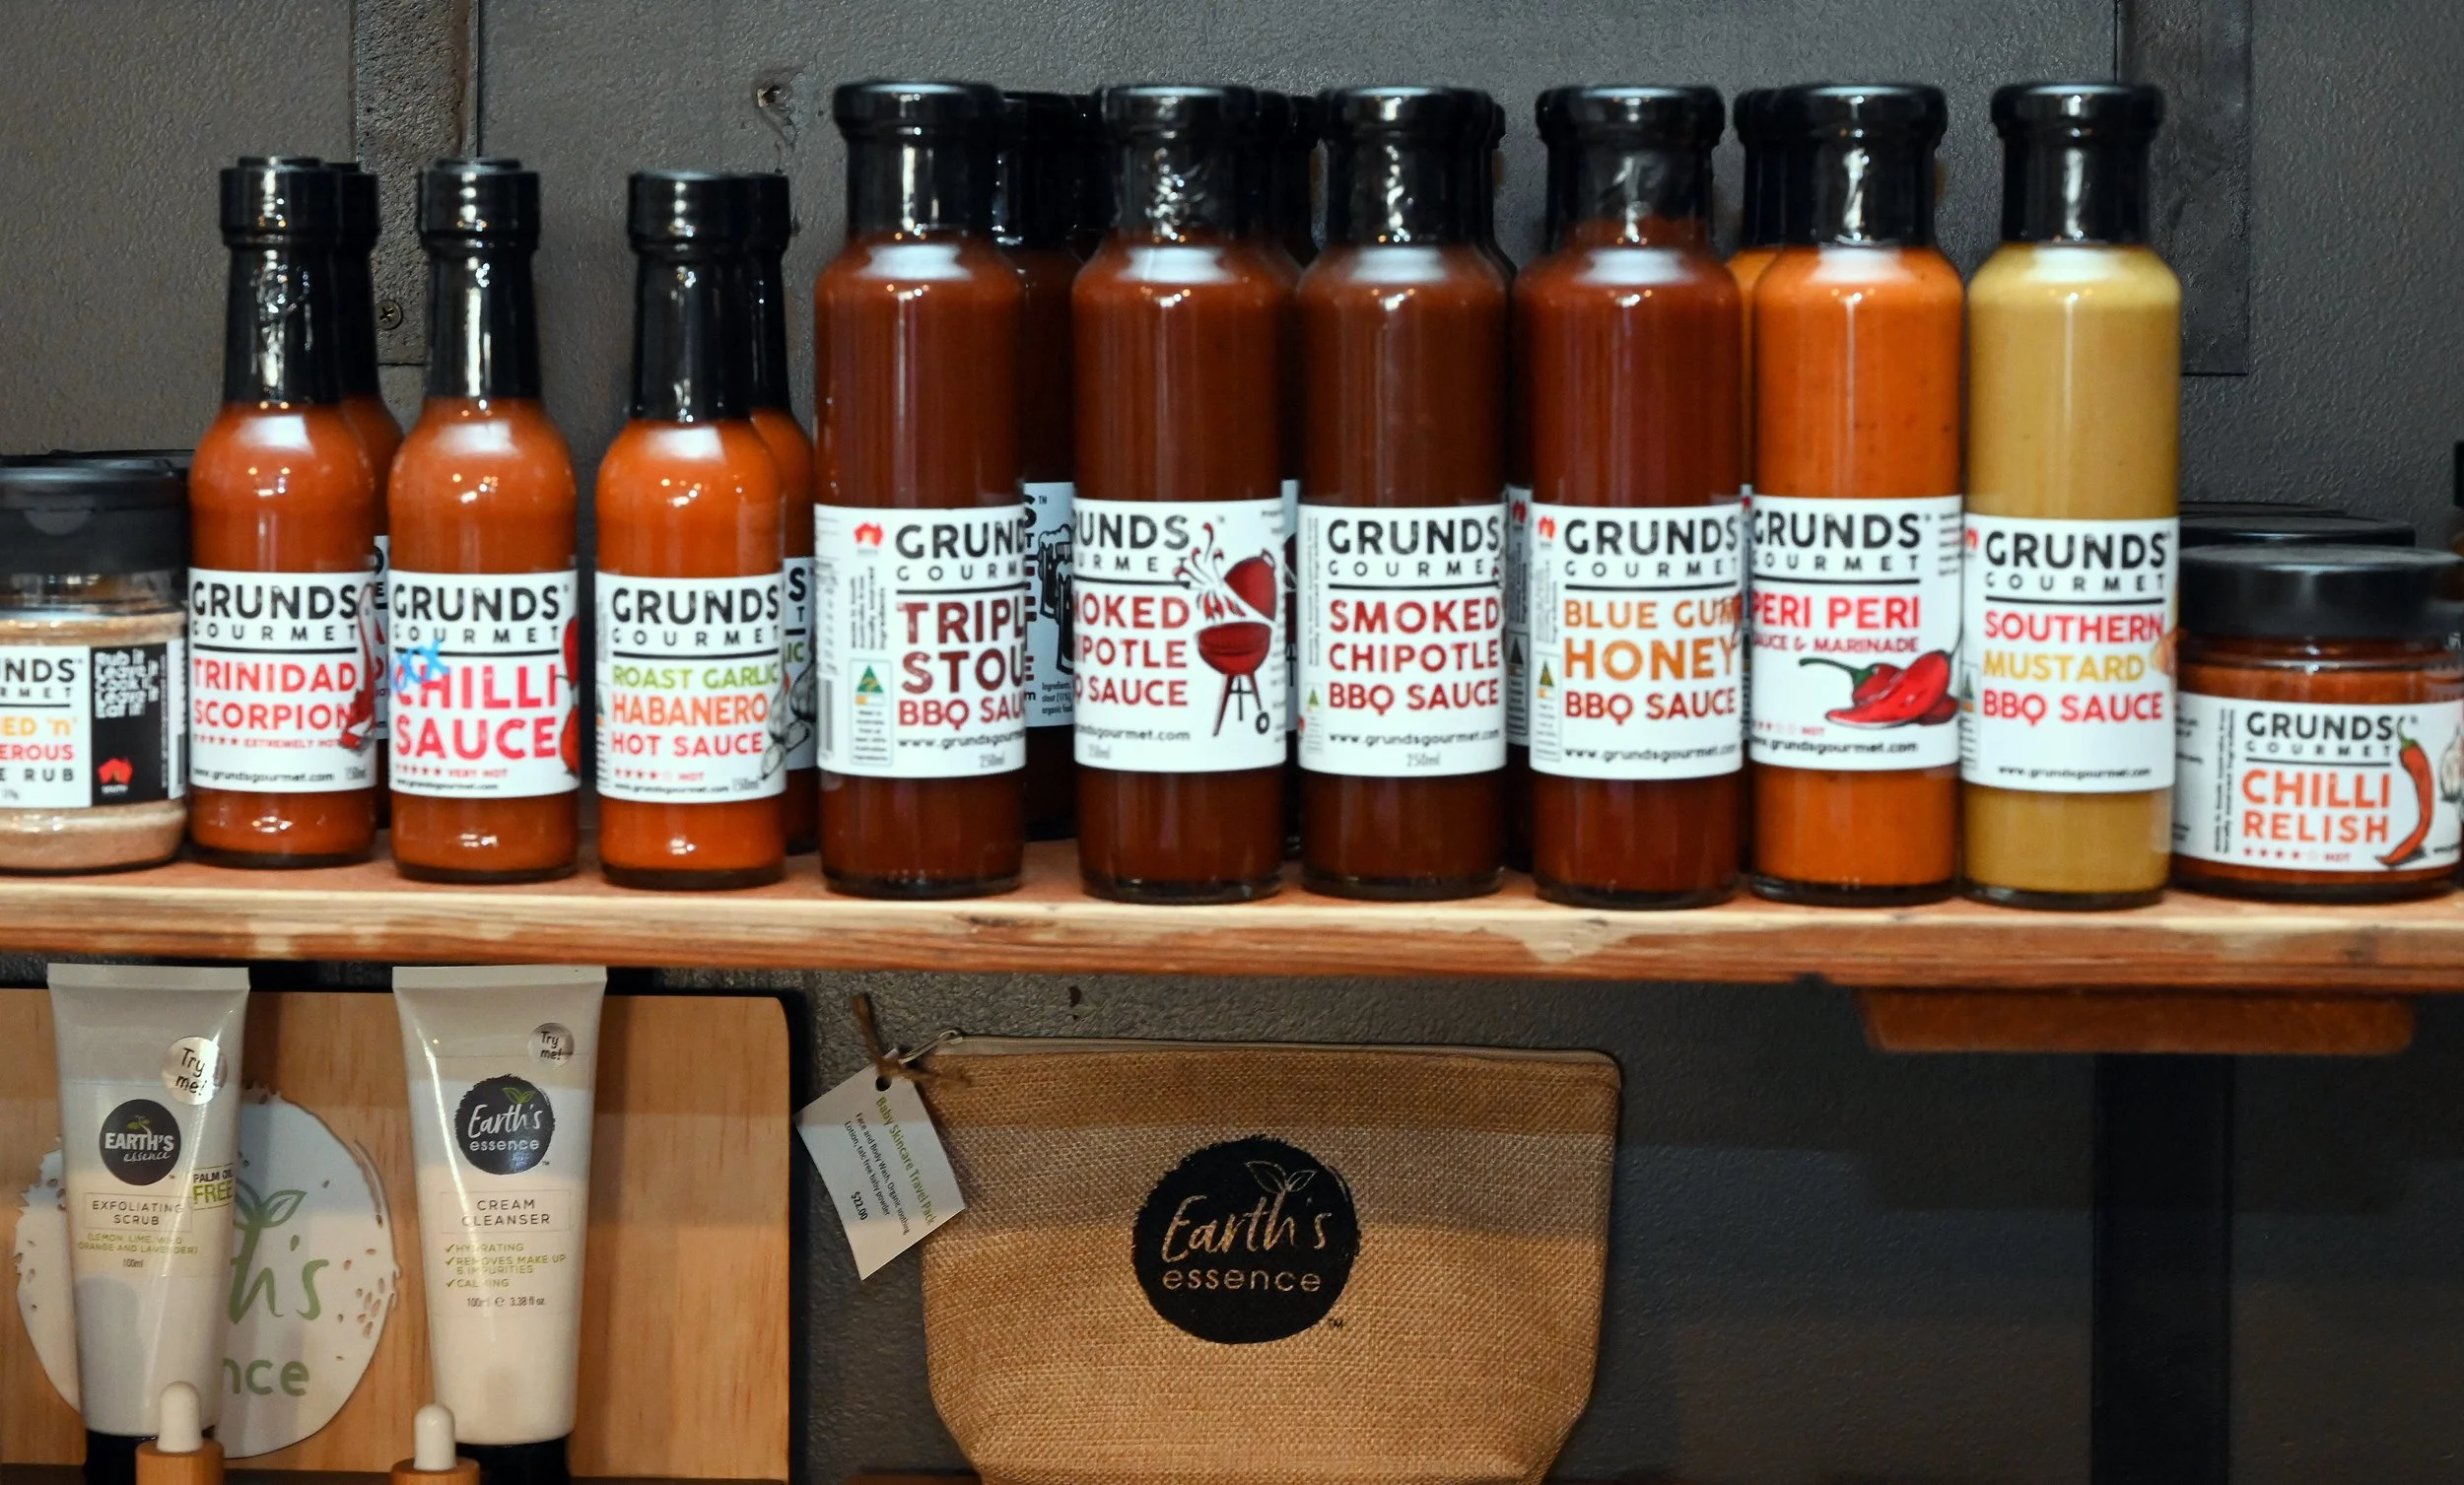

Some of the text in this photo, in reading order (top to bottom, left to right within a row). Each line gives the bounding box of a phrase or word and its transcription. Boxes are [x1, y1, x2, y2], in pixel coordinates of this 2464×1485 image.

[896, 518, 1025, 560] GRUN
[1078, 510, 1190, 550] UNDS
[1328, 515, 1499, 556] GRUNDS
[1564, 515, 1737, 556] GRUNDS
[1753, 510, 1921, 548] GRUNDS
[1985, 530, 2166, 570] GRUNDS
[897, 561, 1020, 581] GOURM
[1985, 572, 2165, 592] GOURMET
[192, 580, 358, 621] GRUNDS
[394, 583, 560, 622] GRUNDS
[612, 584, 779, 625] GRUNDS
[1075, 592, 1190, 629] OKED
[1329, 596, 1499, 634] SMOKED
[1564, 599, 1659, 630] BLUE
[1827, 595, 1920, 630] PERI
[896, 595, 1025, 644] TRIPL
[1984, 609, 2165, 642] SOUTHERN
[1077, 634, 1188, 669] POTLE
[1329, 640, 1499, 673] CHIPOTLE
[1564, 637, 1737, 681] HONEY
[1794, 635, 1808, 651] &
[1814, 637, 1920, 654] MARINADE
[4, 657, 76, 684] NDS
[193, 657, 358, 694] TRINIDAD
[613, 662, 779, 690] ROAST GARLIC
[901, 643, 1025, 695] STOU
[1982, 649, 2146, 682] MUSTARD
[395, 663, 558, 709] CHILLI
[1088, 676, 1188, 707] SAUCE
[1329, 682, 1395, 716] BBQ
[1406, 678, 1499, 711] SAUCE
[193, 699, 354, 730] SCORPION
[612, 692, 770, 727] HABANERO
[899, 694, 1025, 730] BBQ SAU
[1565, 690, 1633, 726] BBQ
[1646, 687, 1736, 720] SAUCE
[1982, 688, 2164, 726] BBQ SAUCE
[3, 715, 37, 737] ED
[395, 714, 558, 760] SAUCE
[2246, 711, 2393, 741] GRUNDS
[0, 743, 75, 762] EROUS
[612, 732, 764, 758] HOT SAUCE
[2246, 740, 2391, 757] GOURMET
[24, 768, 75, 781] RUB
[2241, 768, 2391, 809] CHILLI
[2242, 809, 2389, 844] RELISH
[540, 1048, 563, 1060] me!
[541, 1030, 560, 1048] Try
[181, 1046, 206, 1078] Try
[174, 1074, 206, 1096] me!
[468, 1103, 543, 1138] Earth's
[104, 1132, 174, 1152] EARTH'S
[123, 1150, 172, 1163] essence
[469, 1138, 540, 1152] essence
[193, 1172, 220, 1182] PALM
[863, 1129, 875, 1145] and
[870, 1142, 882, 1163] Body
[887, 1181, 901, 1208] Organic
[876, 1096, 937, 1226] Baby Skincare Travel Pack
[192, 1179, 235, 1204] FREE
[856, 1145, 866, 1161] talc
[862, 1159, 872, 1175] free
[869, 1174, 881, 1193] baby
[875, 1190, 890, 1216] powder
[92, 1200, 184, 1215] EXFOLIATING
[113, 1215, 160, 1226] SCRUB
[461, 1213, 551, 1227] CLEANSER
[476, 1199, 536, 1211] CREAM
[851, 1190, 868, 1221] $22.00
[1161, 1190, 1333, 1263] Earth's
[78, 1242, 114, 1251] ORANGE
[117, 1244, 137, 1252] AND
[455, 1243, 524, 1252] HYRATING
[517, 1254, 549, 1264] MAKE
[552, 1253, 567, 1263] UP
[1162, 1268, 1323, 1292] essence
